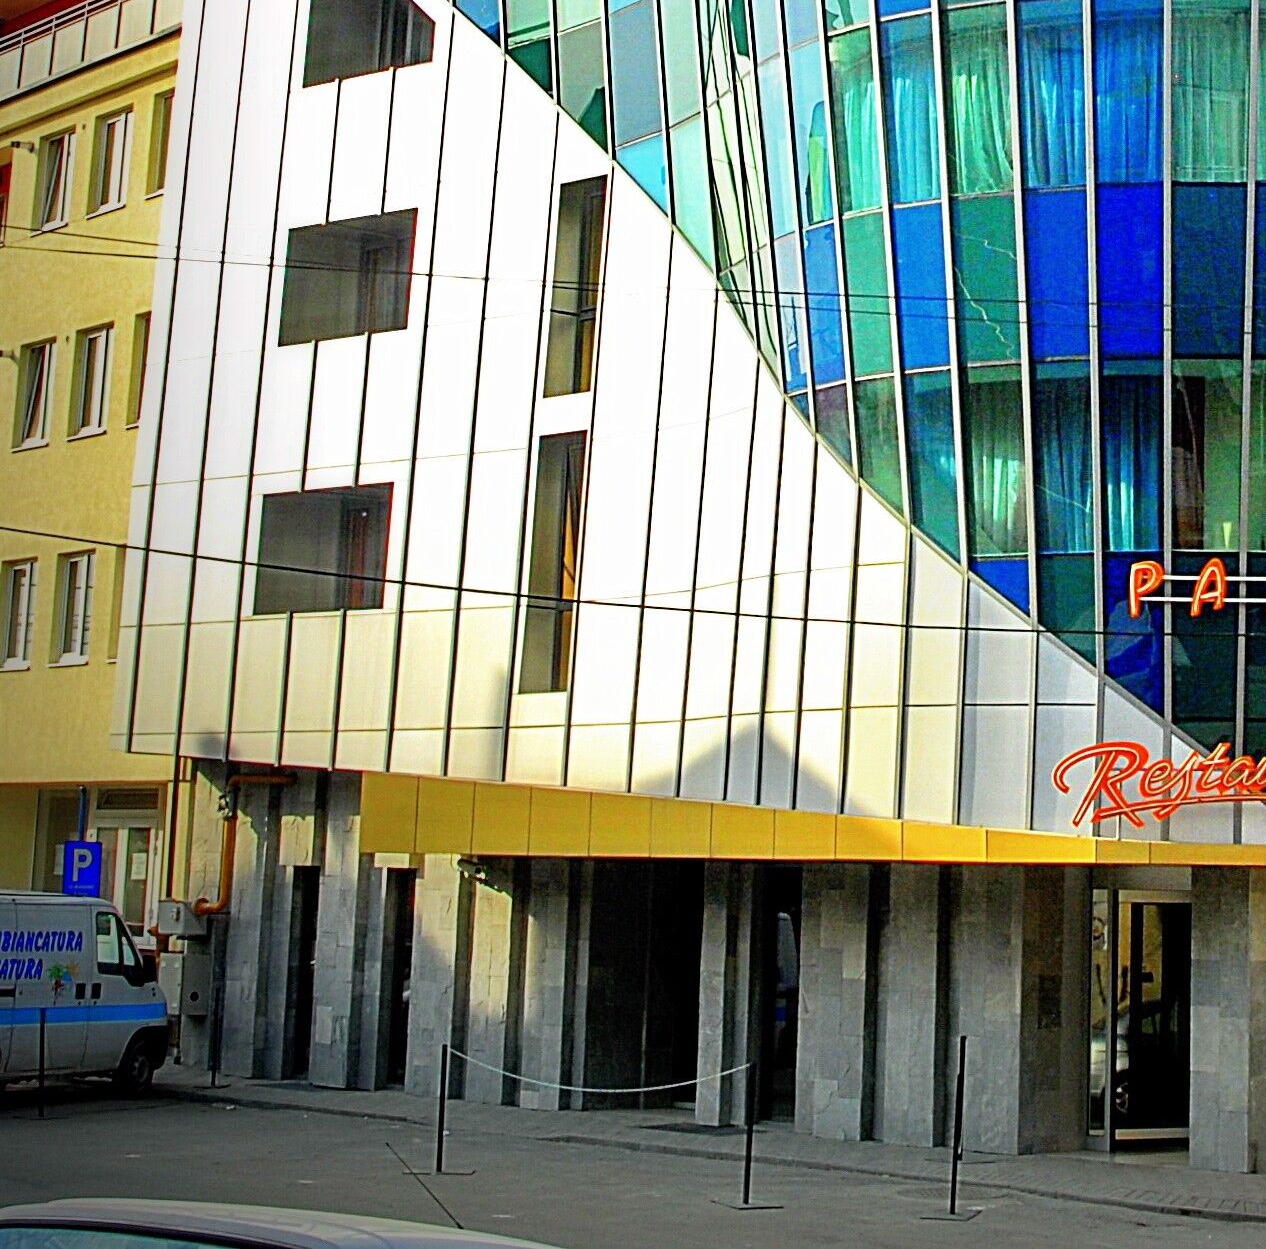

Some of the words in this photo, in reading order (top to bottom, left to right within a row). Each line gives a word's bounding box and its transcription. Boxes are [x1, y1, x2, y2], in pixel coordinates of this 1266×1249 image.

[72, 848, 93, 882] P
[0, 930, 83, 952] BIANCATURA
[0, 958, 43, 980] ATURA
